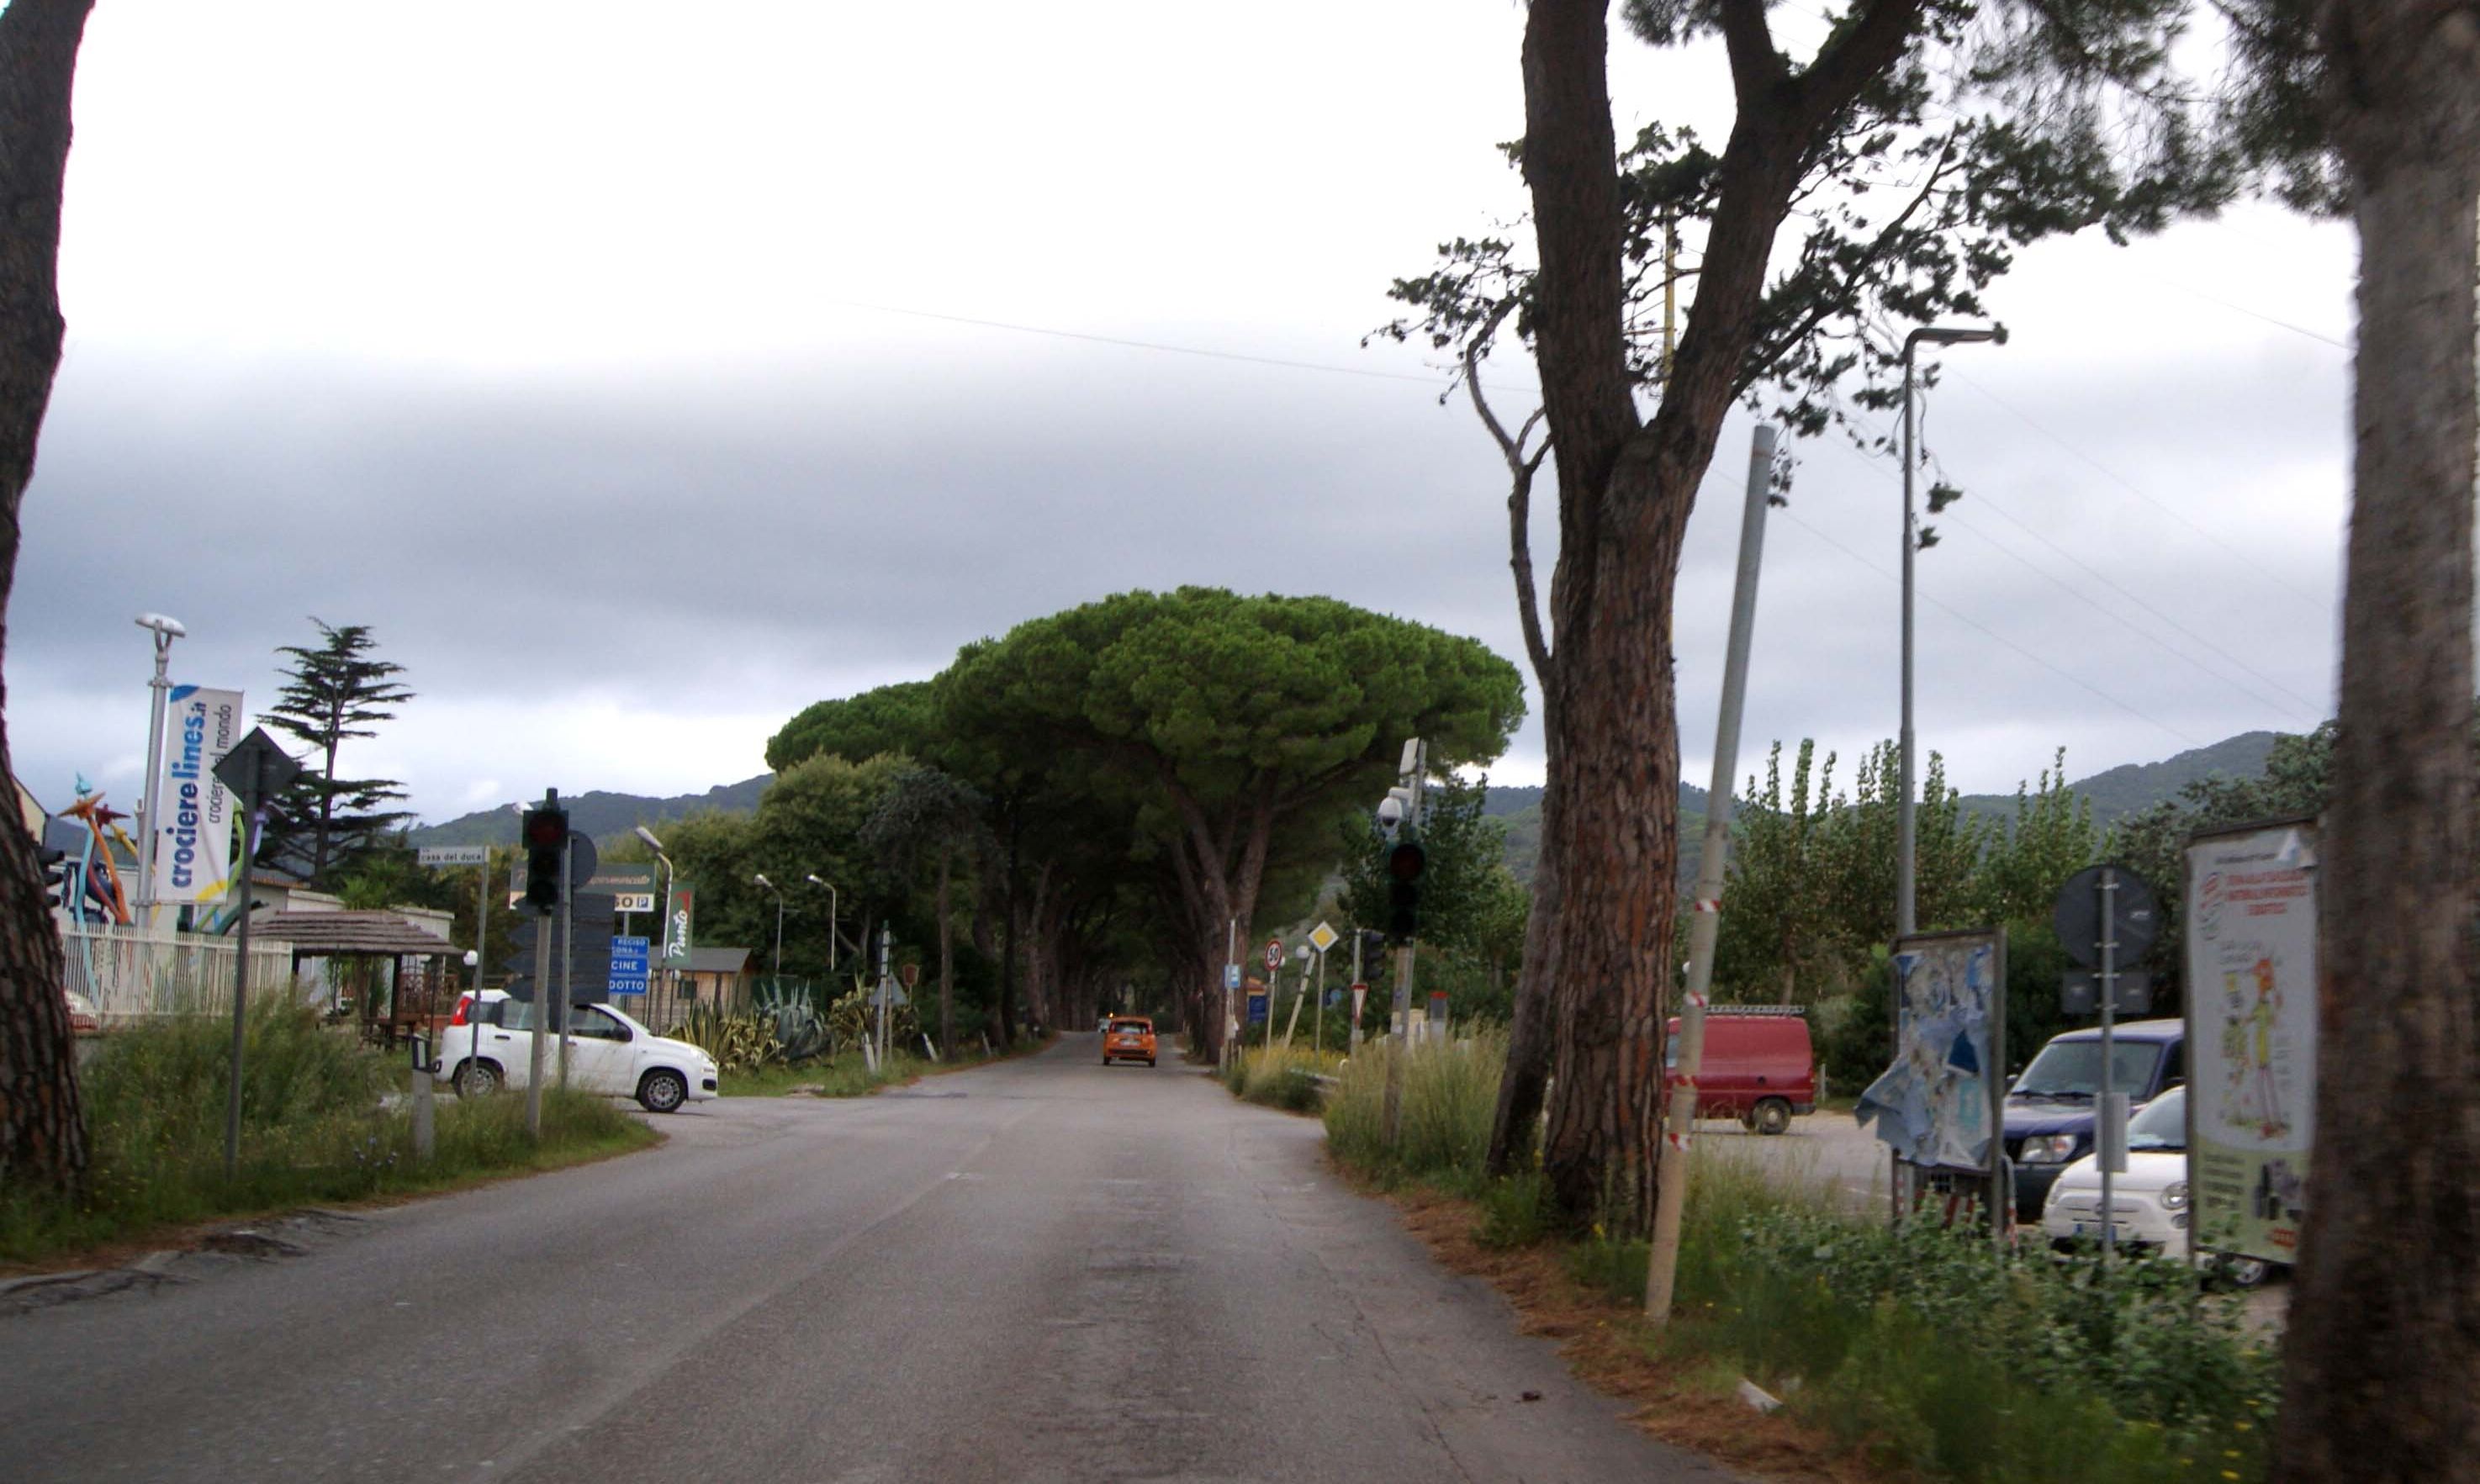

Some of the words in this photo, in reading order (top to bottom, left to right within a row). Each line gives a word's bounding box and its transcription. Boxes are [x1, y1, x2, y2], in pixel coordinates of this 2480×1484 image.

[214, 704, 231, 749] mondo
[421, 853, 441, 862] casa
[443, 852, 457, 862] del
[460, 852, 481, 861] duca
[669, 910, 688, 958] Punto
[1269, 947, 1278, 962] 50
